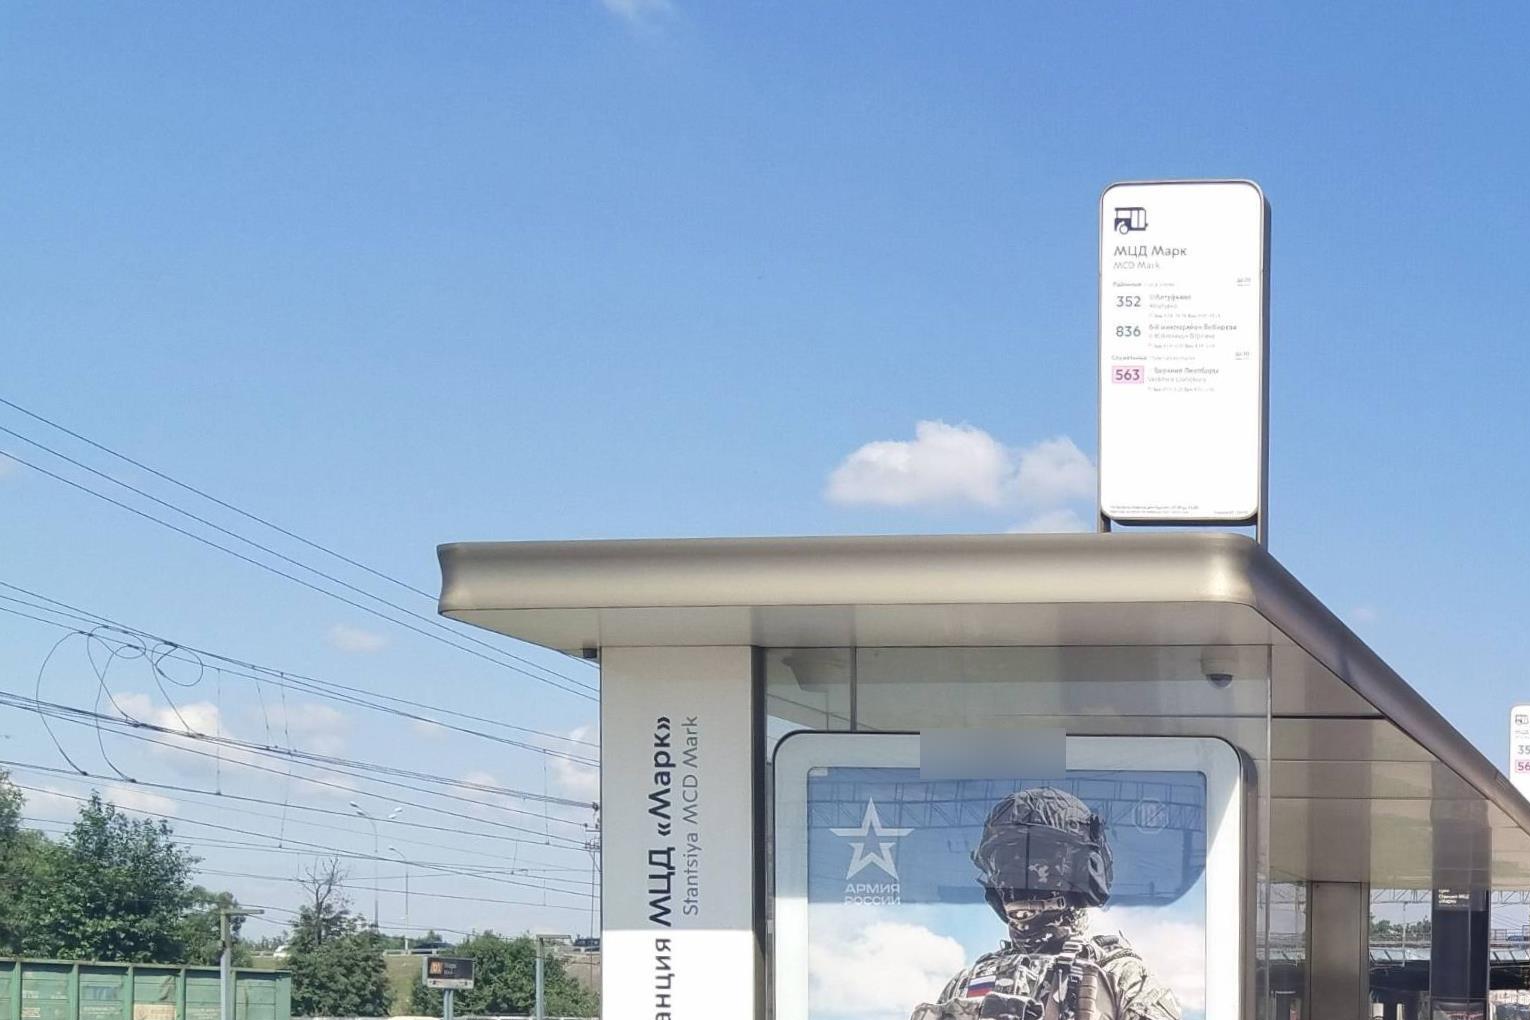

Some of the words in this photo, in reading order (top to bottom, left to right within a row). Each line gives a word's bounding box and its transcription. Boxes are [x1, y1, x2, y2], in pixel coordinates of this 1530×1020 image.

[1113, 245, 1148, 258] МЦД
[1151, 245, 1188, 259] Марк
[1116, 295, 1142, 308] 352
[1115, 325, 1142, 338] 836
[1115, 369, 1141, 381] 563
[681, 715, 699, 768] Mark
[648, 716, 677, 837] «Марк»
[682, 774, 699, 825] MCD
[682, 831, 703, 916] Stantsiya
[648, 846, 676, 927] МЦД
[845, 883, 901, 894] АРМИЯ
[844, 896, 901, 906] РОССИИ
